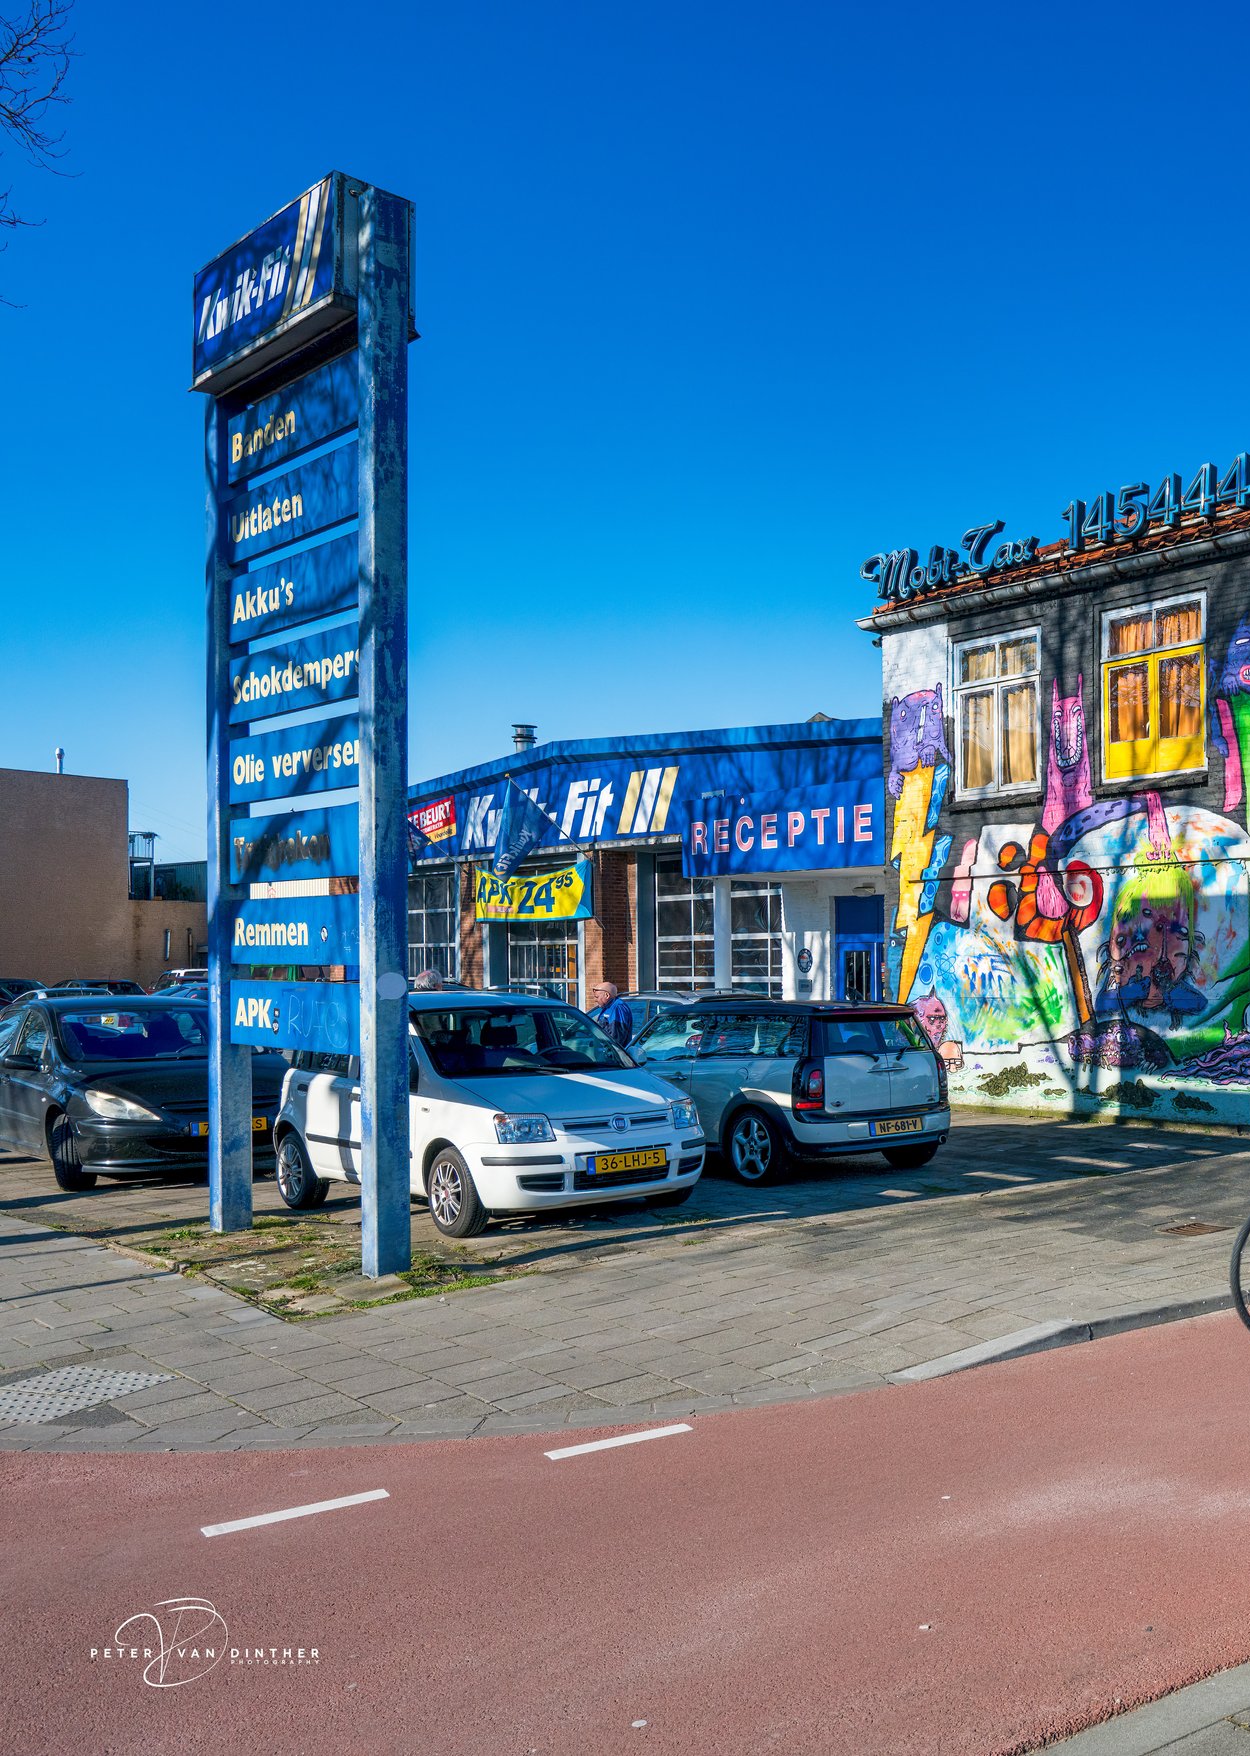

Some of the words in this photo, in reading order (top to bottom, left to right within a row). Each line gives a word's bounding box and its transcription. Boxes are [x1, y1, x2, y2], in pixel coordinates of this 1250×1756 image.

[197, 245, 290, 345] Kwik-Fit
[231, 410, 296, 464] Banden
[231, 492, 303, 544] Uitlaten
[232, 578, 294, 625] Akku's
[233, 754, 265, 785] Olie
[419, 800, 452, 829] BEURT
[691, 803, 873, 856] RECEPTIE
[477, 876, 516, 906] APK
[234, 917, 309, 946] Remmen
[235, 998, 272, 1029] APK
[879, 1119, 918, 1133] NF-681-V
[601, 1152, 660, 1171] 36-LHJ-5
